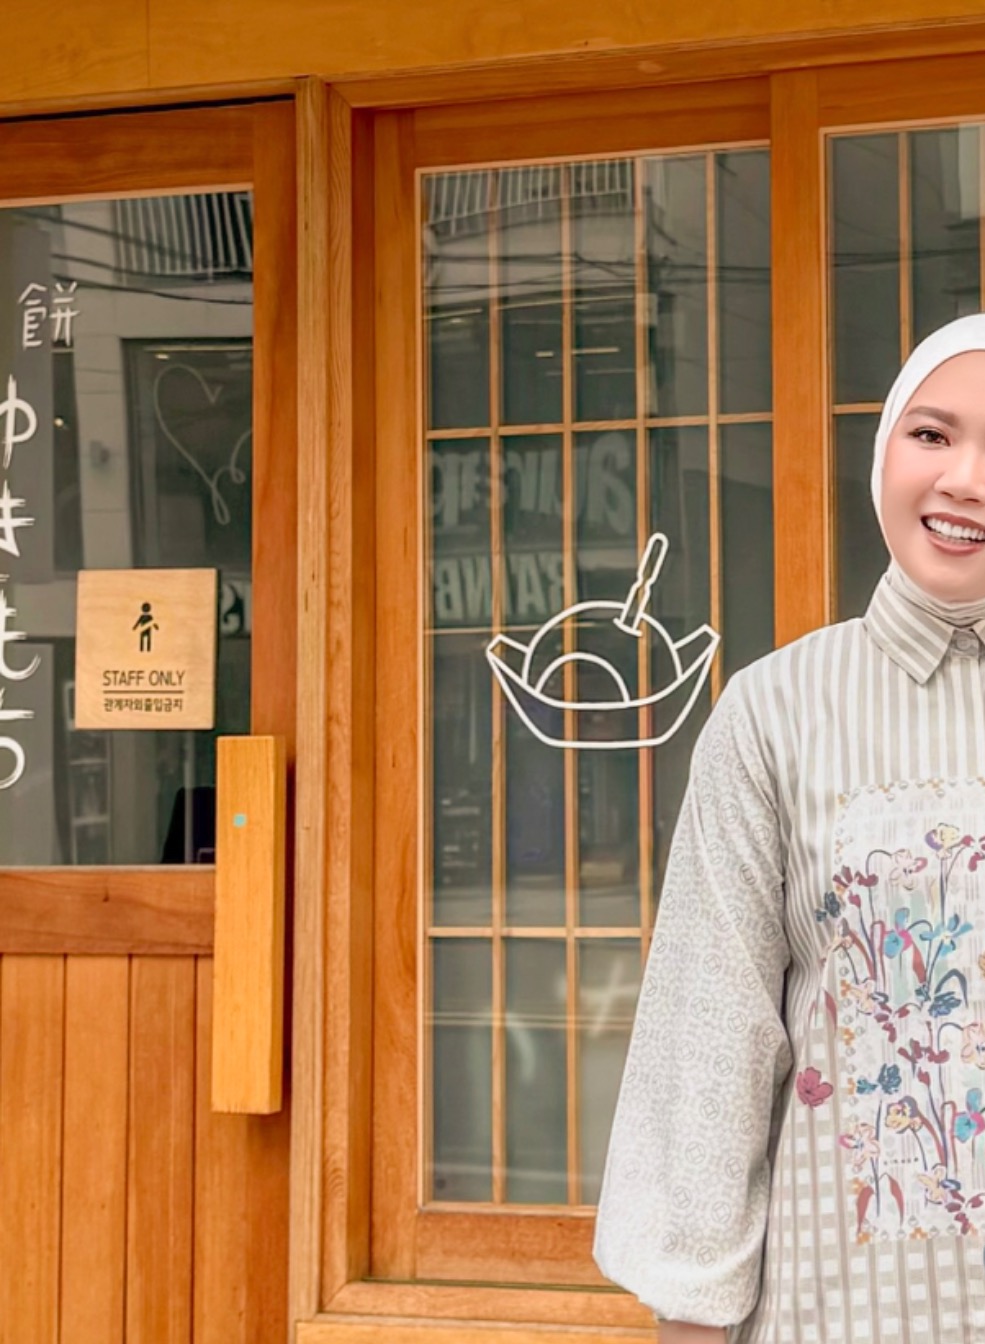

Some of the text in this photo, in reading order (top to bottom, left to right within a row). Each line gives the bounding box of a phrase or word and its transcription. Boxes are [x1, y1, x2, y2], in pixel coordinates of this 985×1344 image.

[103, 671, 185, 686] STAFF ONLY
[105, 698, 183, 712] 관계자외출입금지
